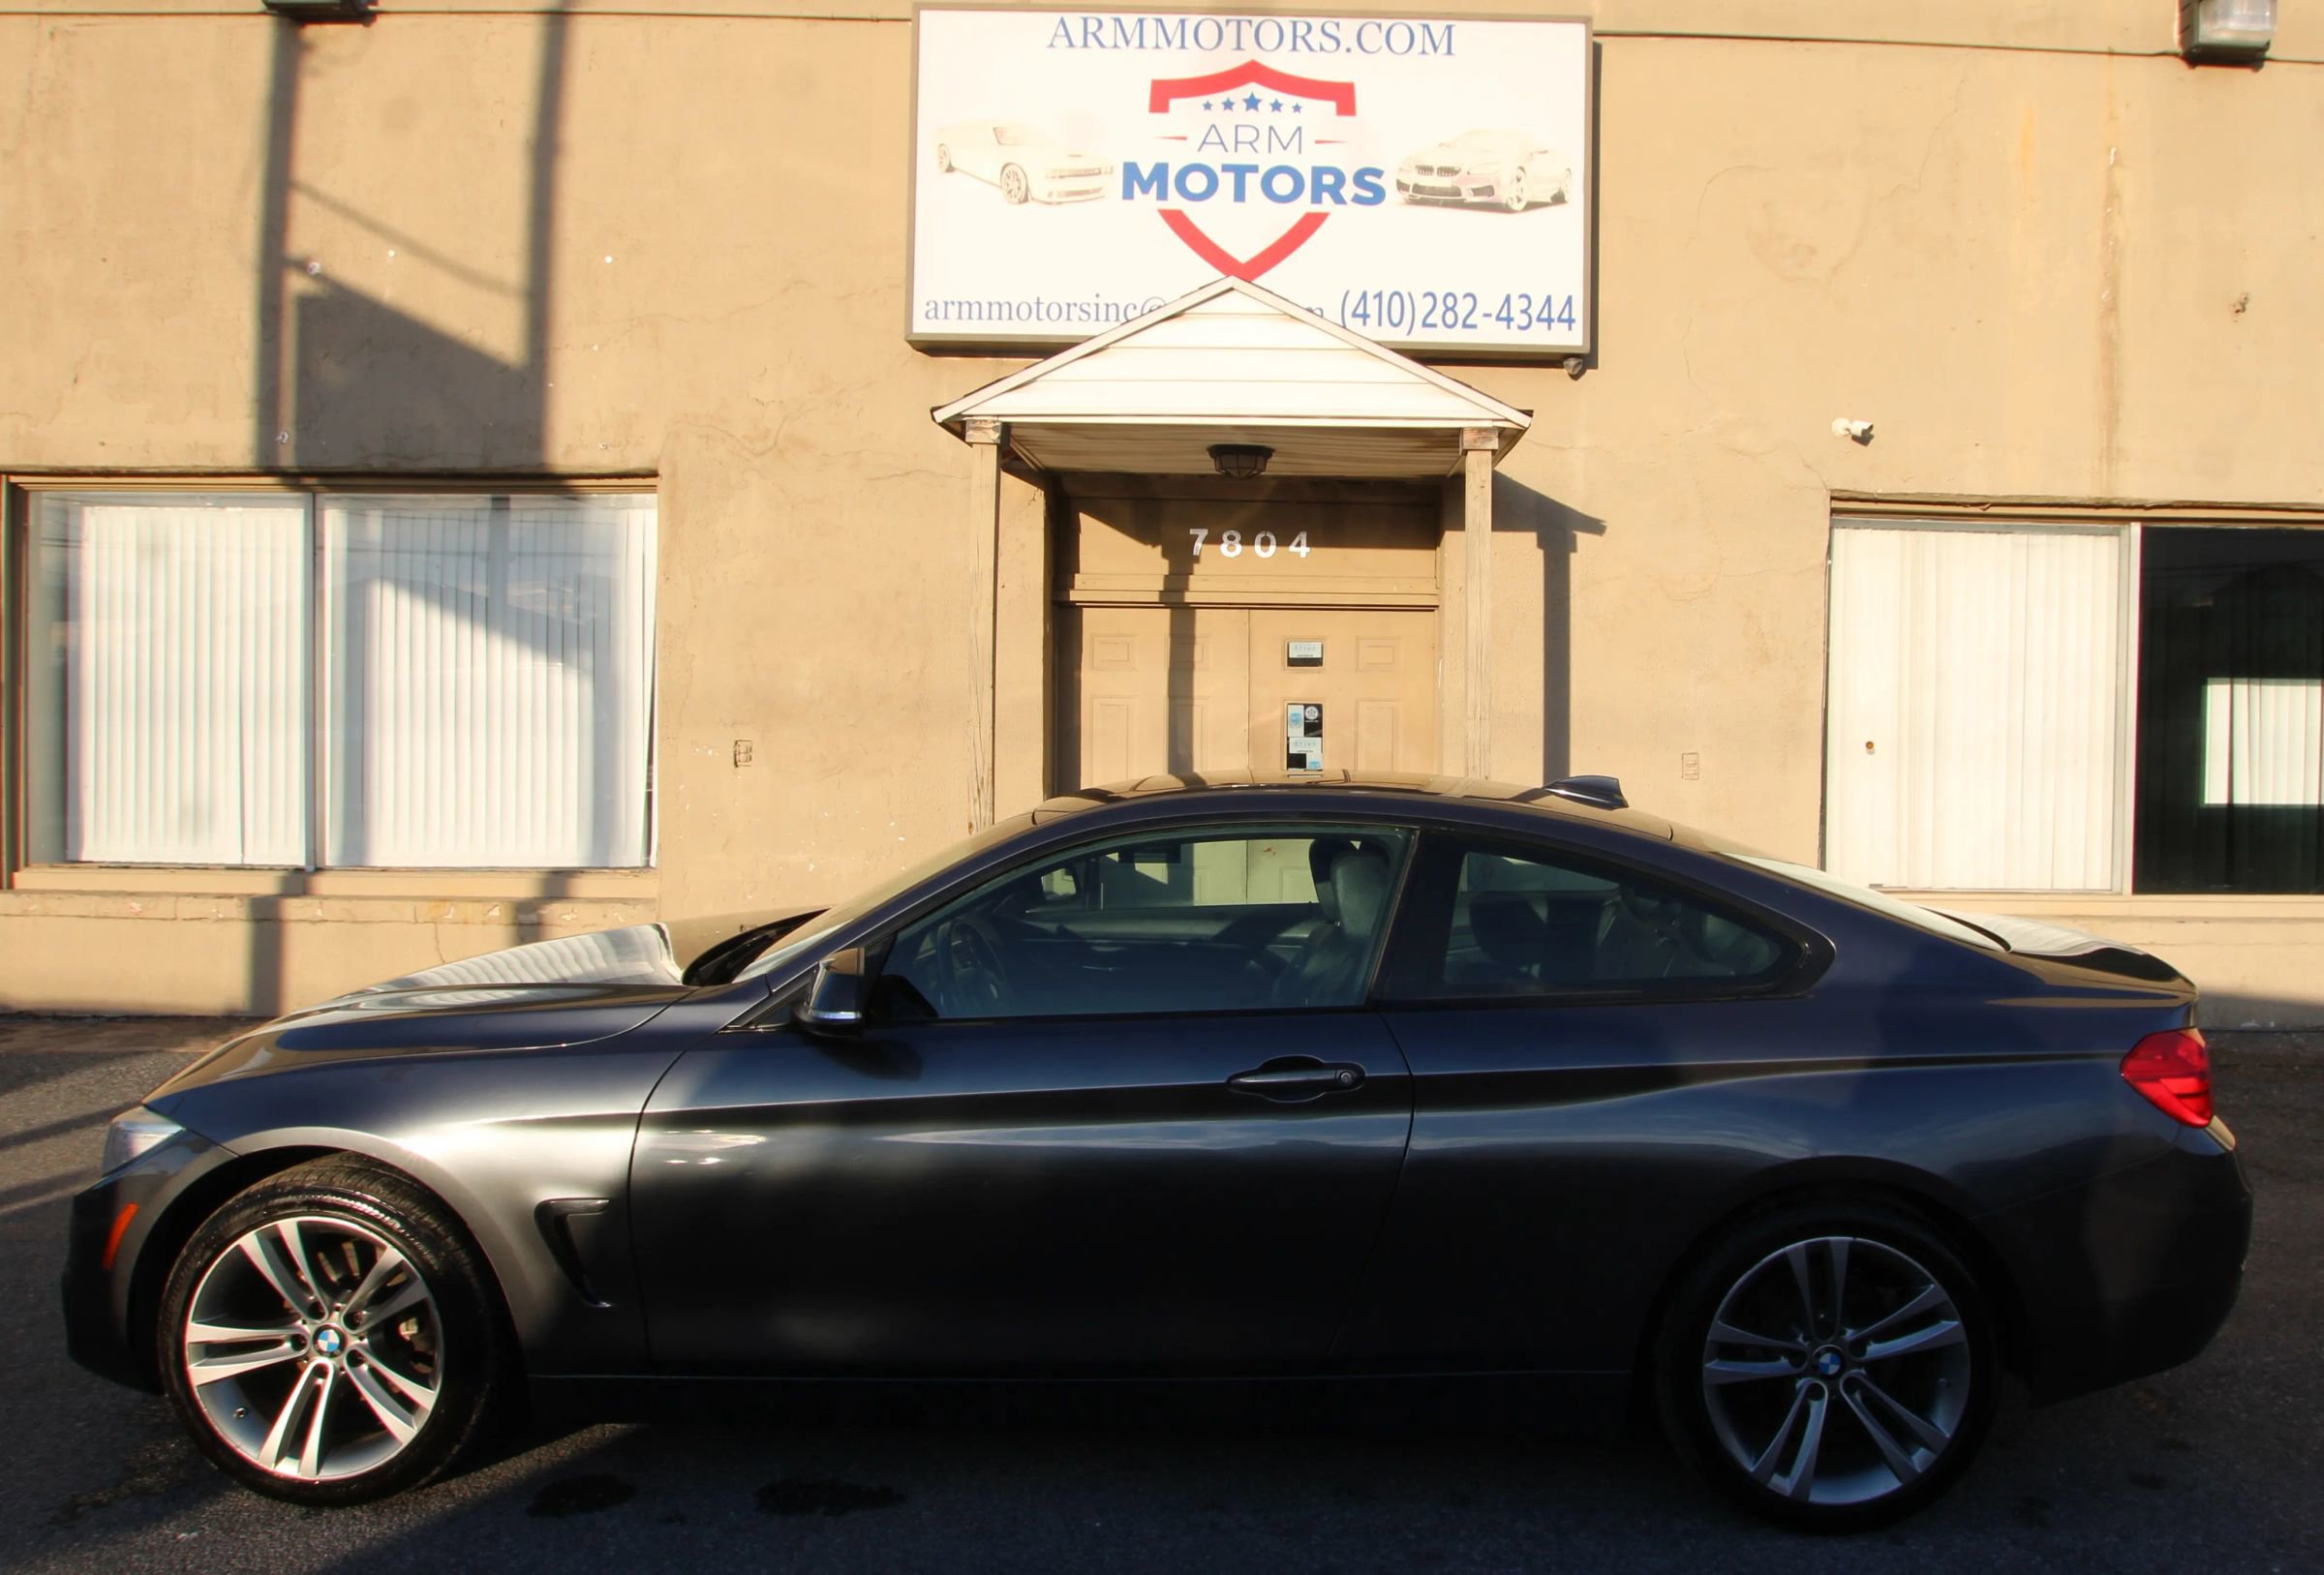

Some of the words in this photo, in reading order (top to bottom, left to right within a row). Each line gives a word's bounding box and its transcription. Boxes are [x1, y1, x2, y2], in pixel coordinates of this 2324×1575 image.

[1047, 16, 1455, 55] ARMMOTORS.COM
[1197, 123, 1302, 155] ARM
[1122, 162, 1386, 206] MOTORS
[1340, 289, 1576, 336] (410)282-4344
[1189, 528, 1311, 559] 7804
